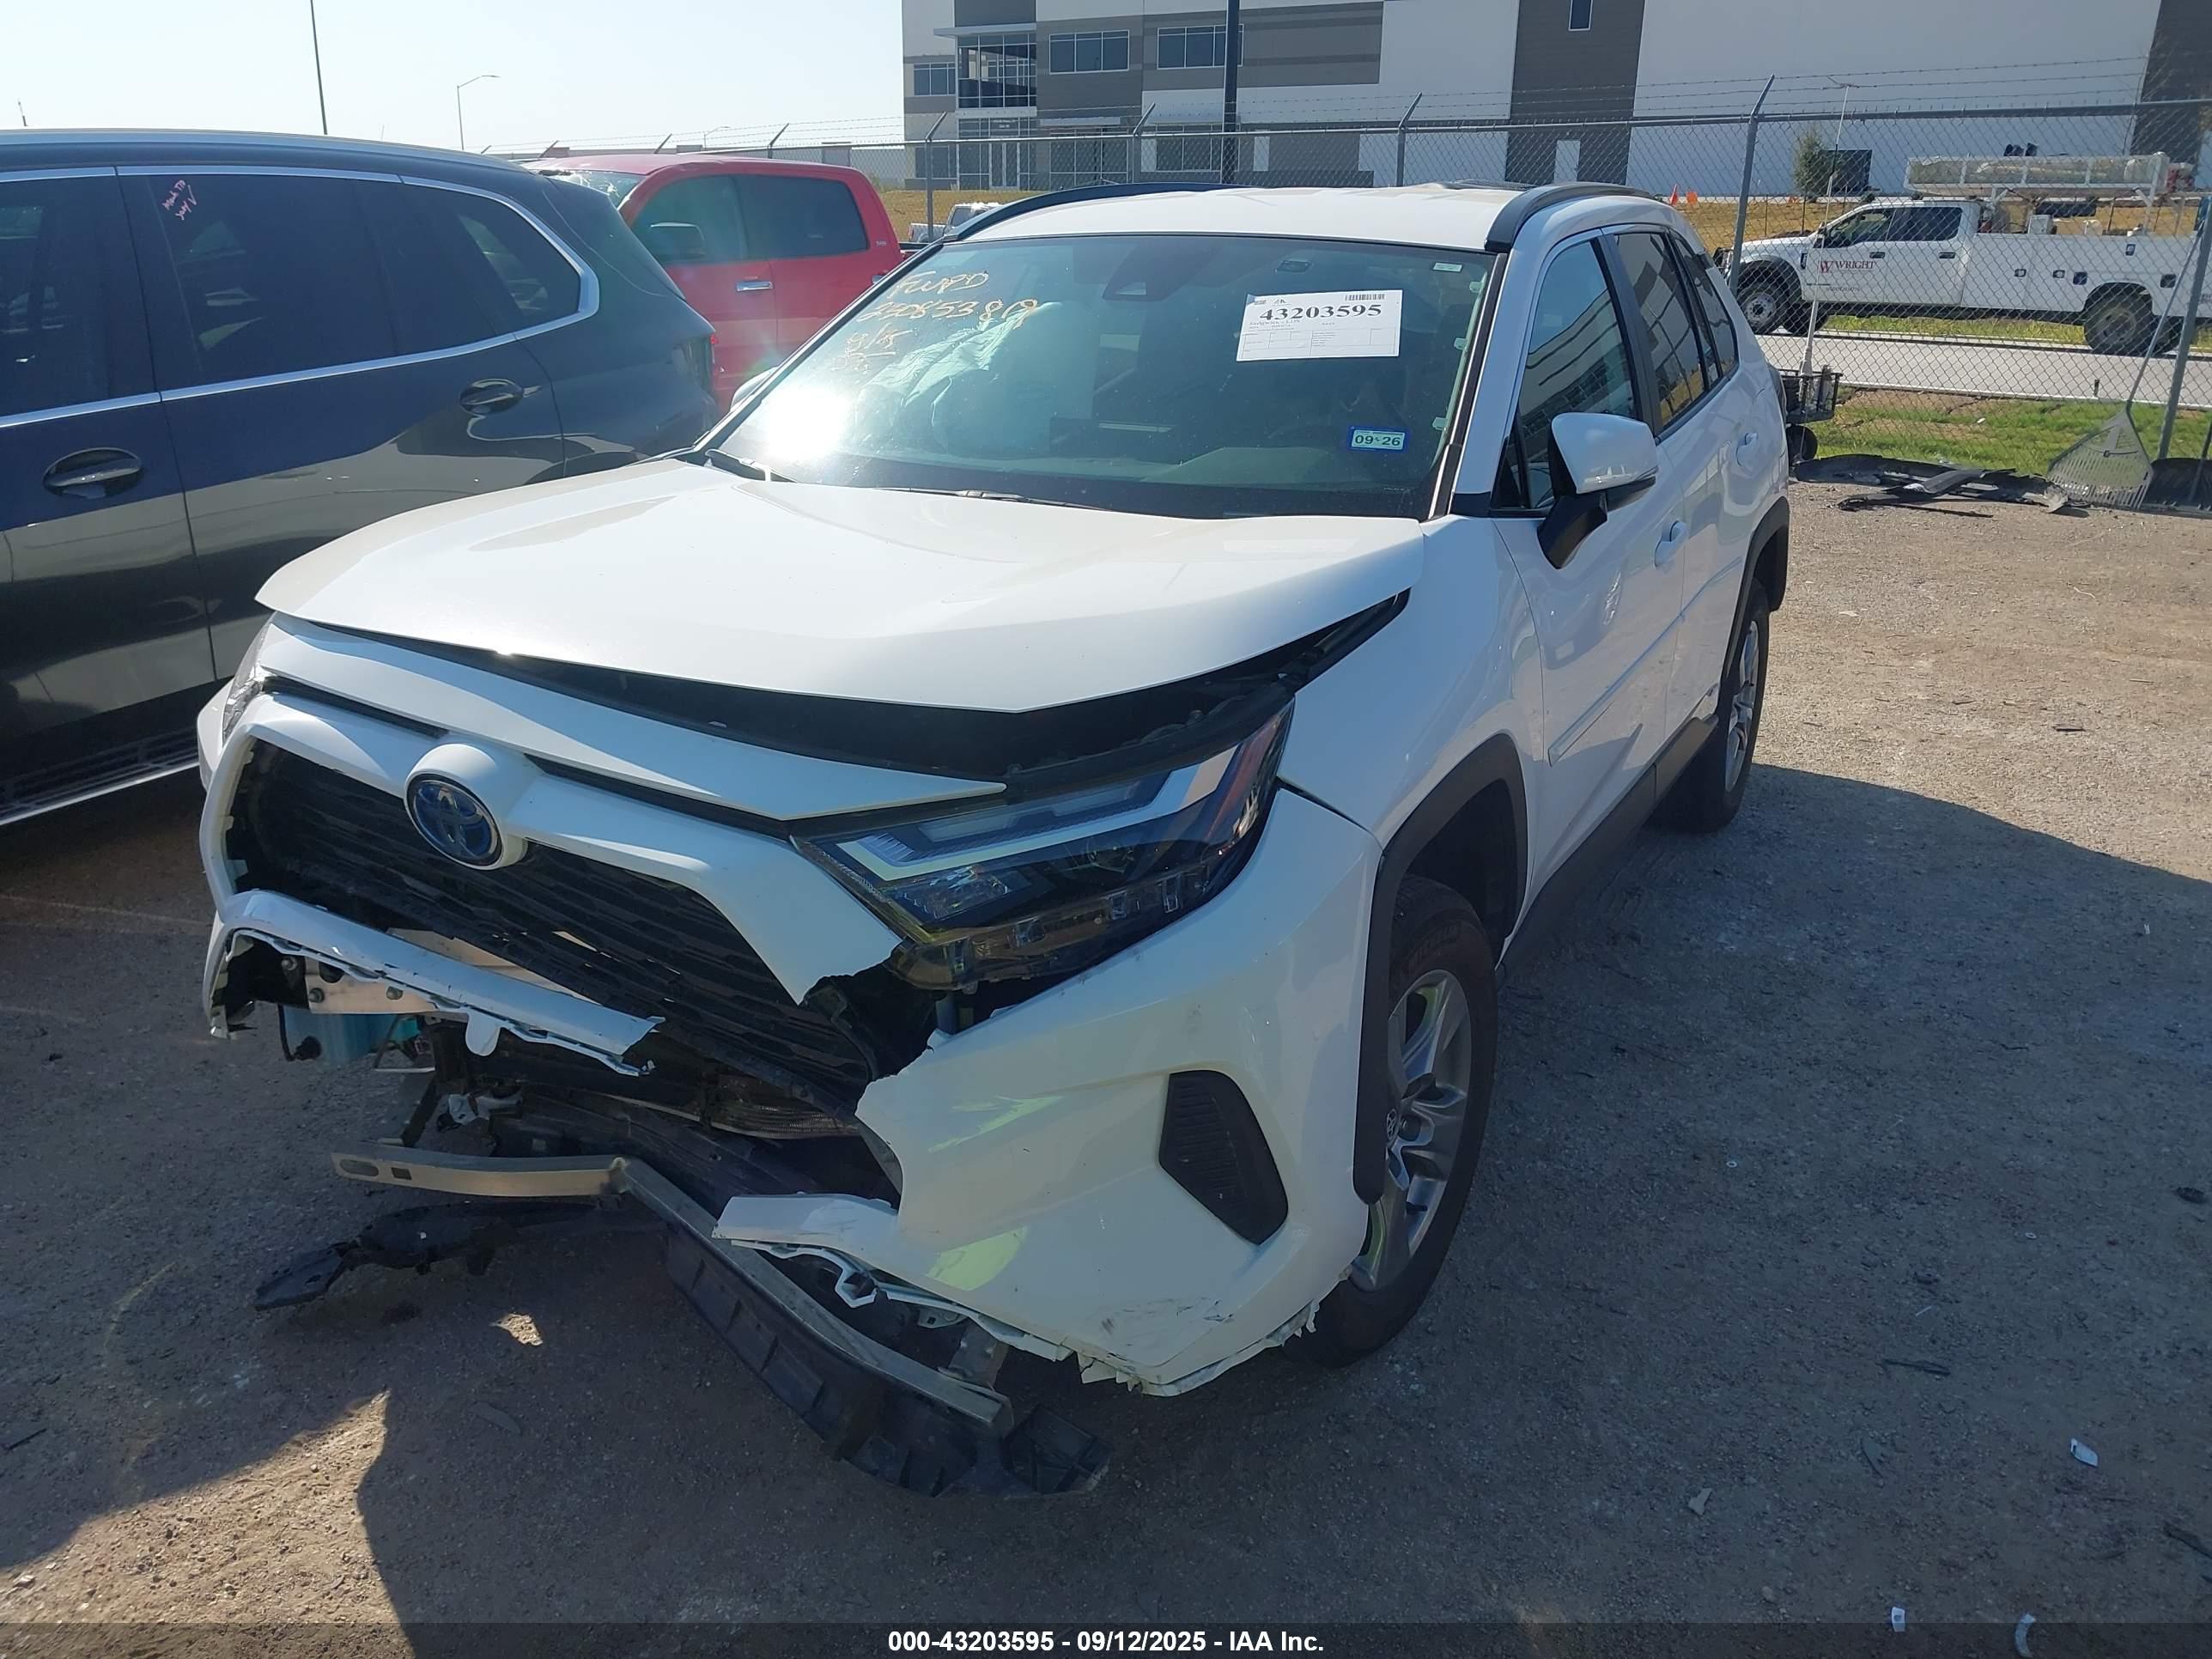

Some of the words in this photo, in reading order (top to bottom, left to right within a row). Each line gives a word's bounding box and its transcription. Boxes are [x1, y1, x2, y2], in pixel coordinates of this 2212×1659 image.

[1834, 260, 1875, 270] WRIGHT
[1260, 304, 1382, 320] 43203595
[1382, 436, 1401, 447] 26
